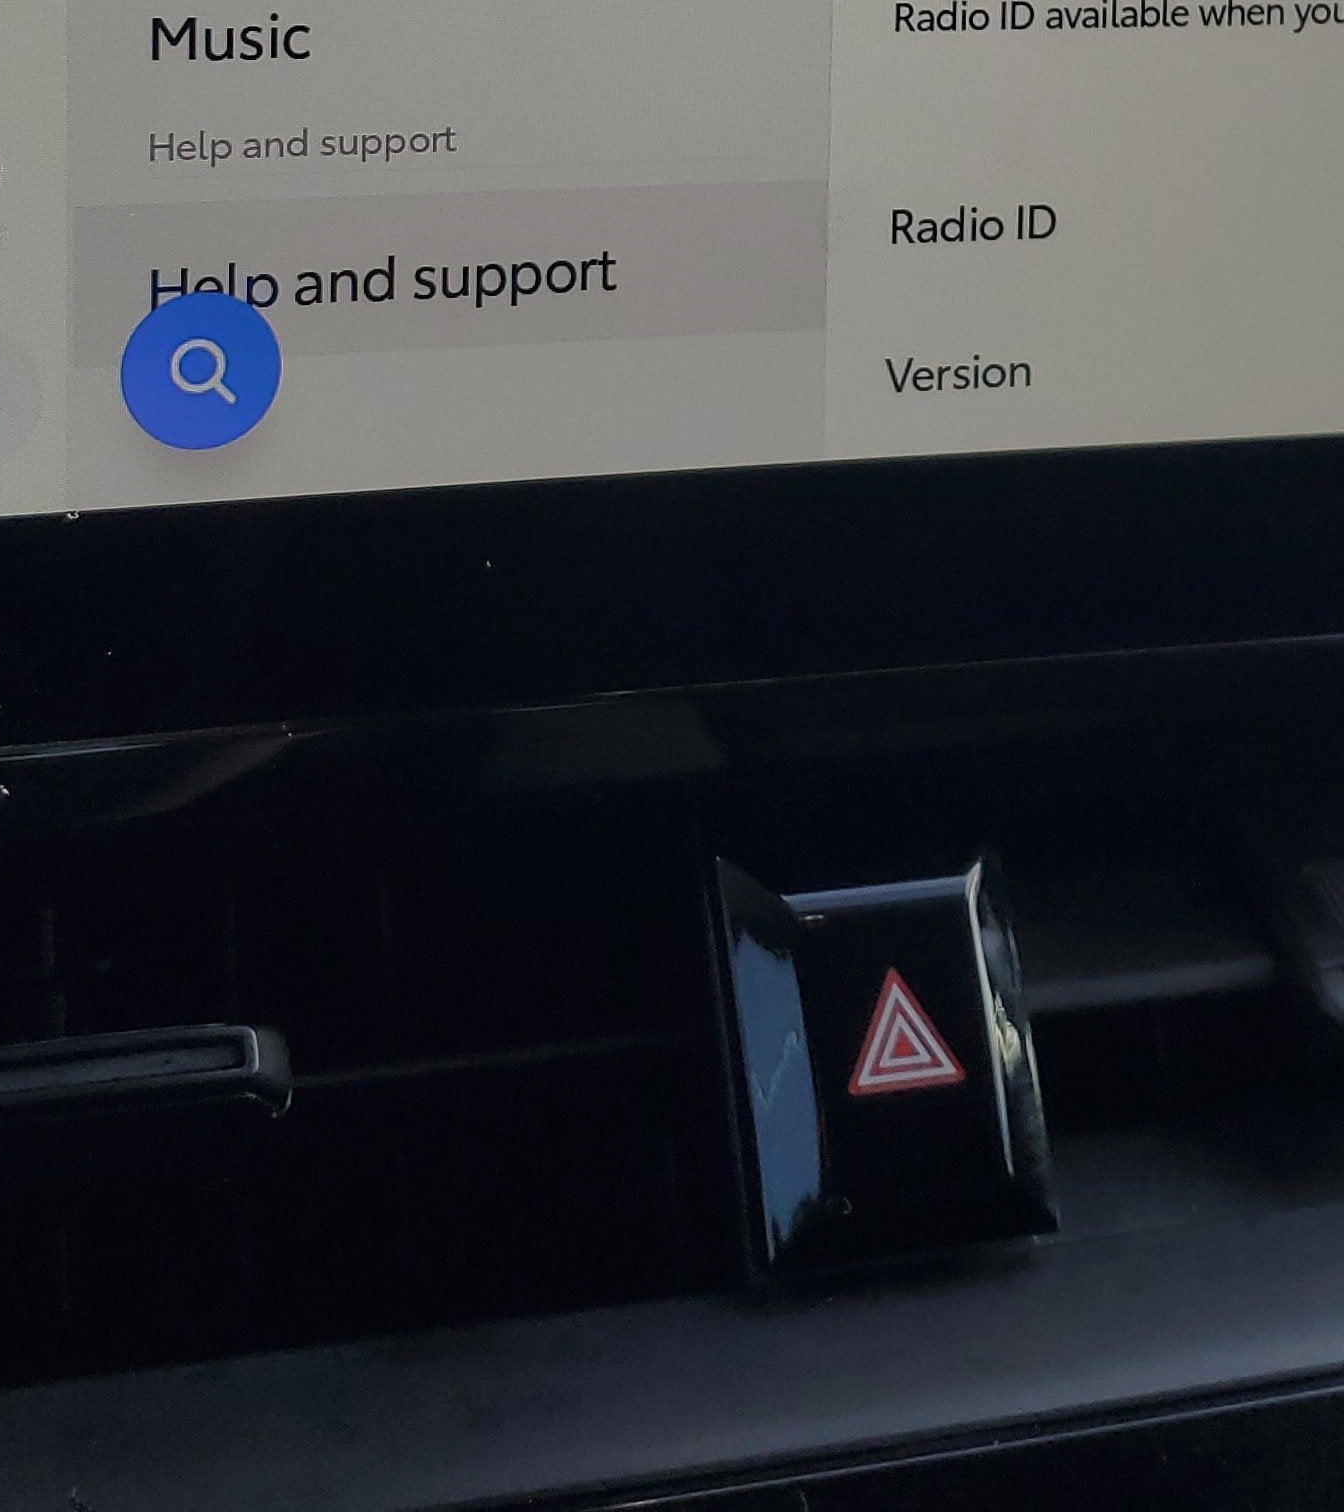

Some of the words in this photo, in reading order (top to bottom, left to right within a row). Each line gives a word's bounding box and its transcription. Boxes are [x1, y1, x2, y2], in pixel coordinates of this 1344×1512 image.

[151, 12, 311, 62] Music
[894, 0, 990, 33] Radio
[1000, 0, 1035, 31] ID
[149, 129, 234, 167] Help
[242, 127, 309, 159] and
[320, 126, 458, 163] support
[891, 205, 1005, 245] Radio
[1017, 204, 1057, 240] ID
[294, 255, 396, 306] and
[413, 250, 618, 308] support
[884, 354, 1031, 394] Version
